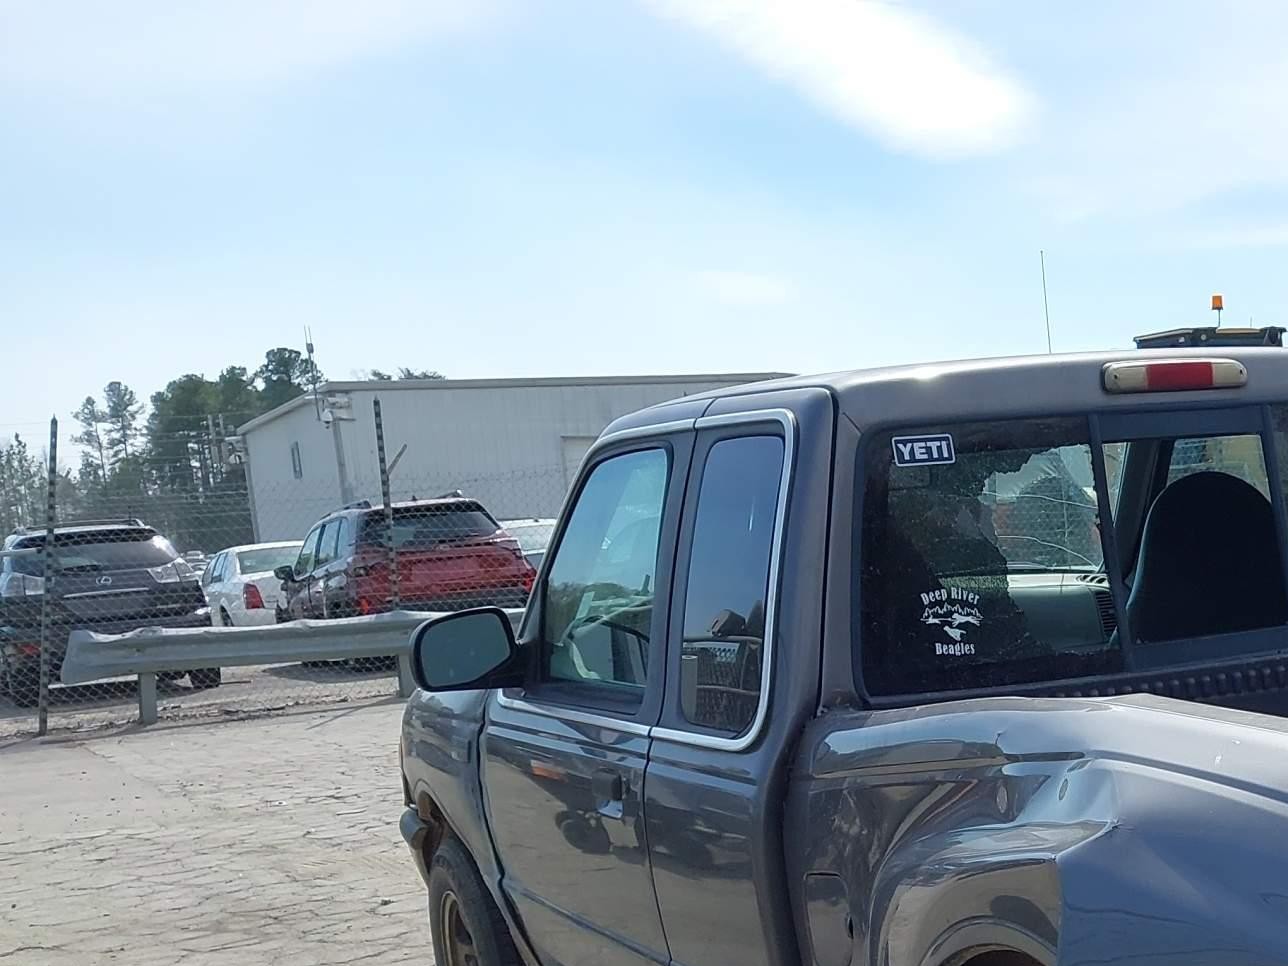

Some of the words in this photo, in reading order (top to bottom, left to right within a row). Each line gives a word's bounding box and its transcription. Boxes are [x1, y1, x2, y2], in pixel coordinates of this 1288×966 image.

[896, 440, 949, 461] YETI
[920, 588, 948, 605] Deep
[951, 587, 980, 605] River
[935, 642, 975, 656] Beagles
